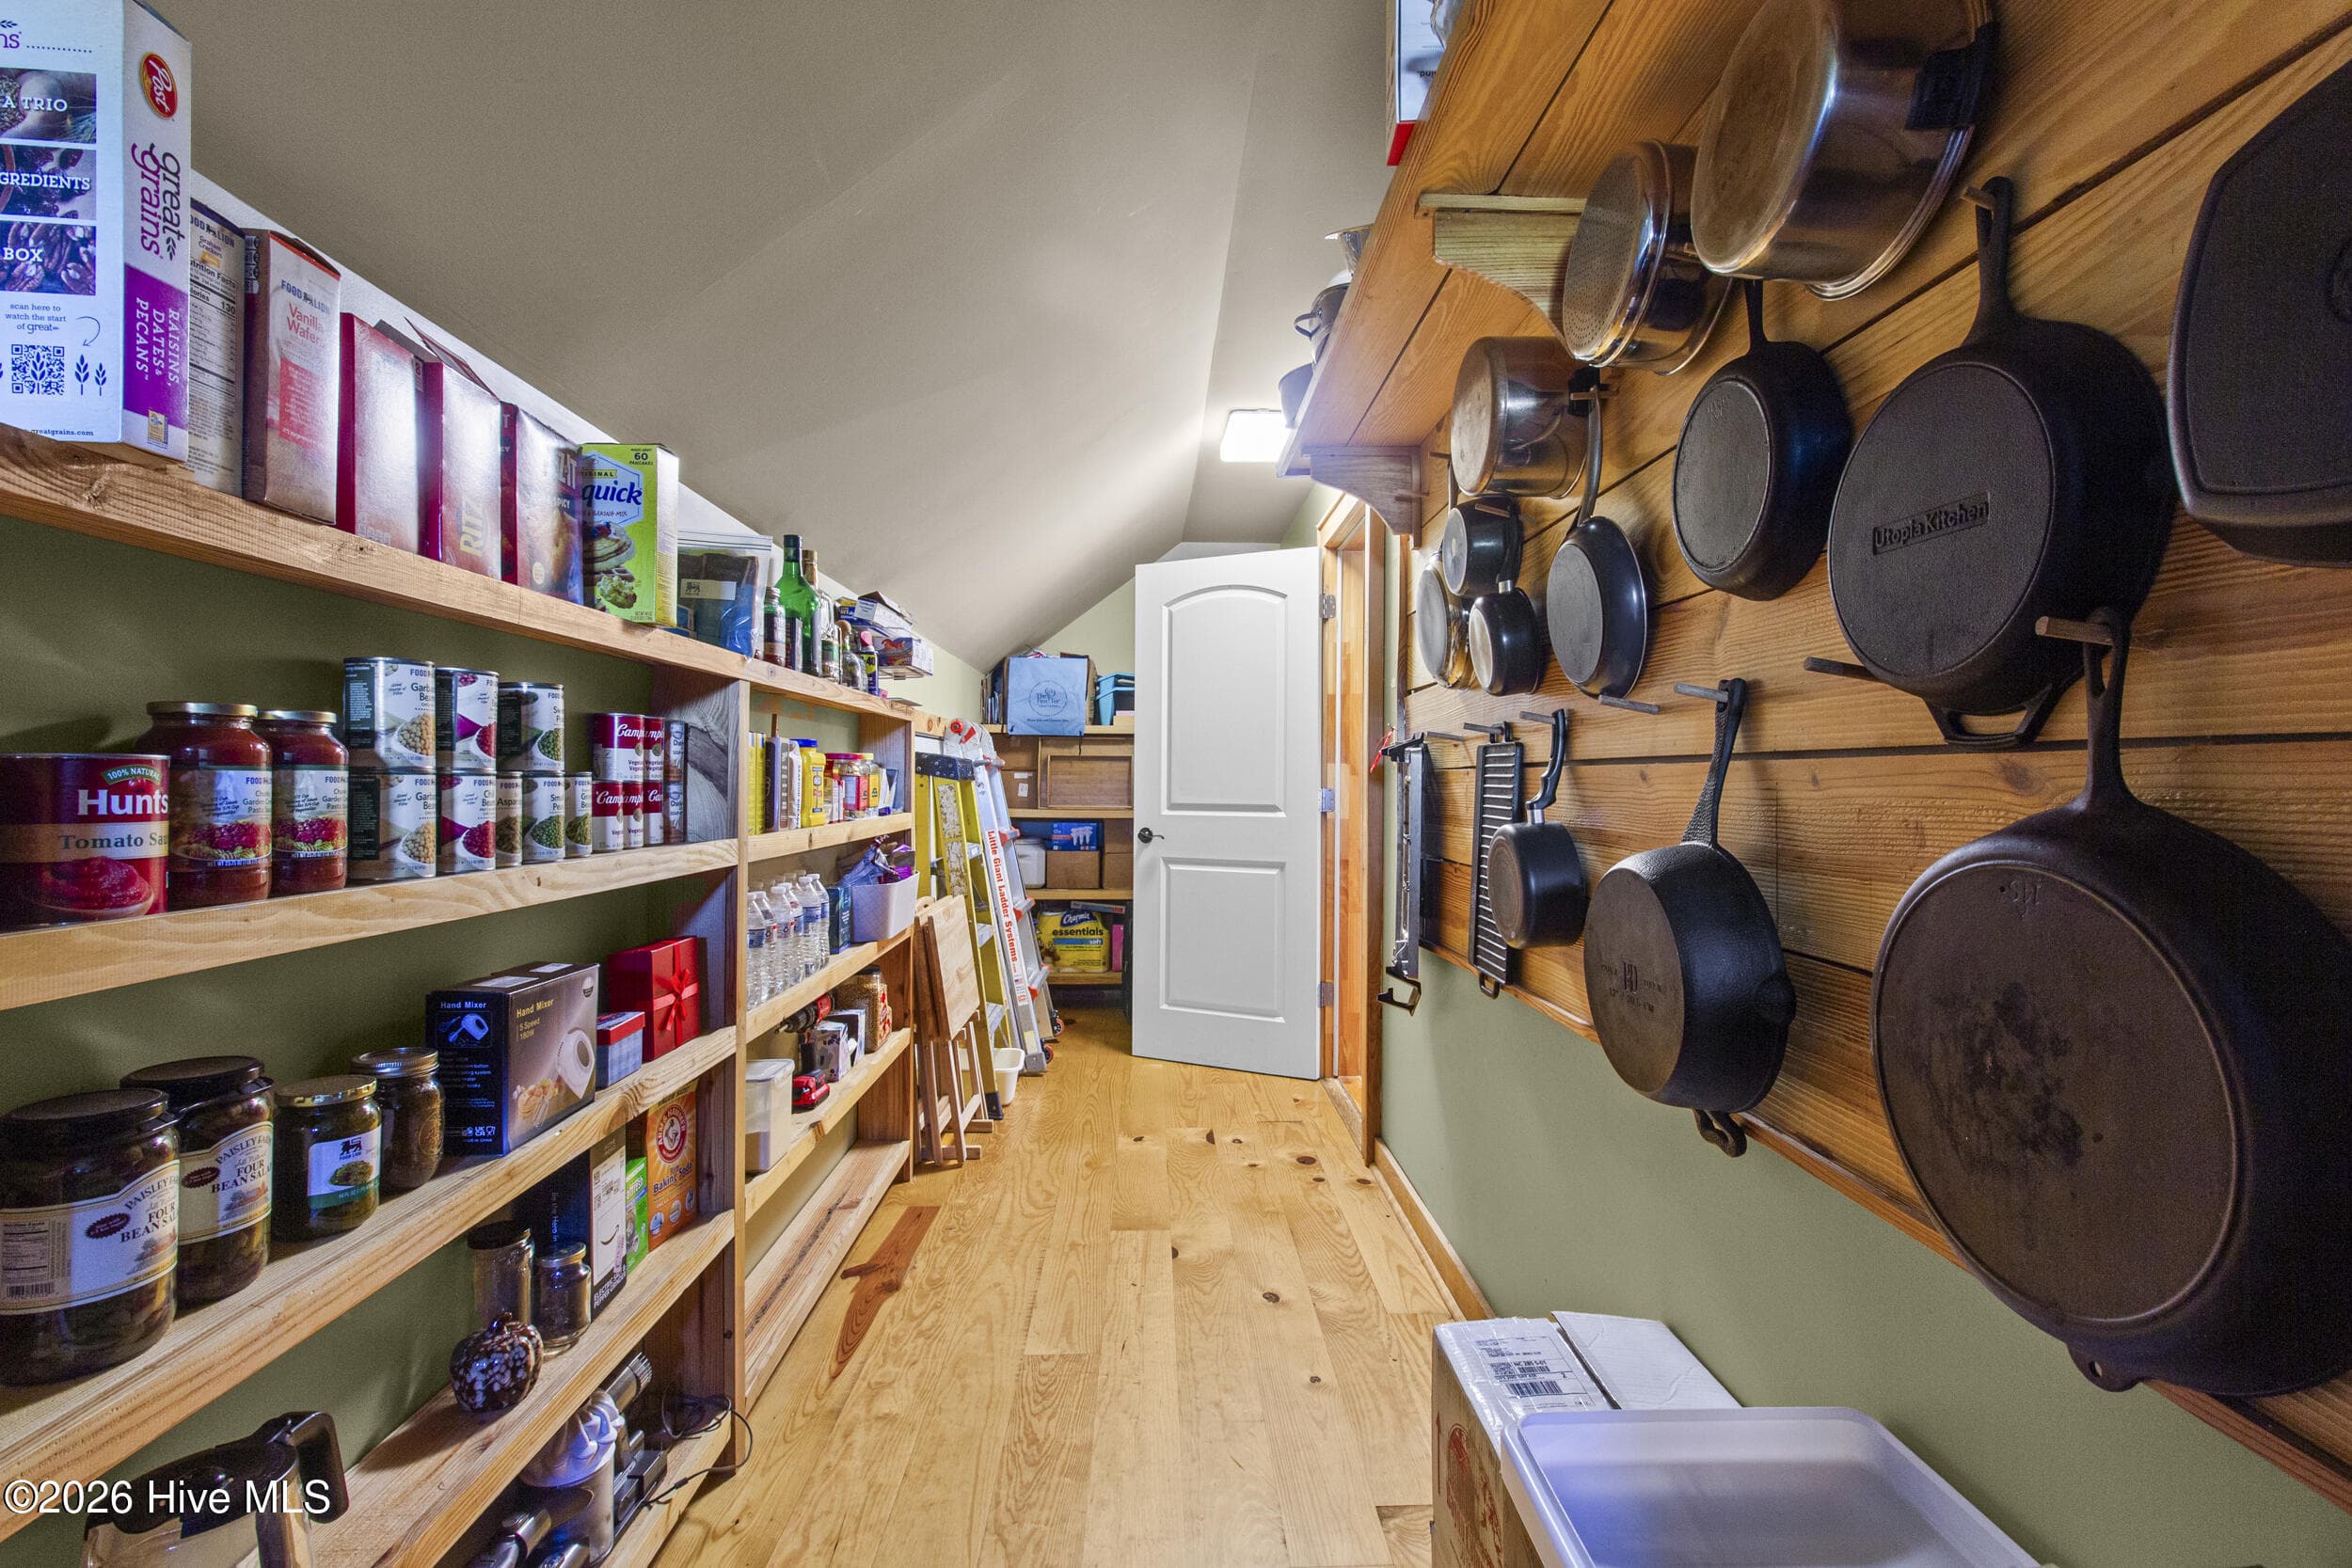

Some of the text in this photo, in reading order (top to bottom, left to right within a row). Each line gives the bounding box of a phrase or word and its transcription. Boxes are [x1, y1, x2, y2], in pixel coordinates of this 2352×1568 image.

[148, 57, 173, 113] Post
[2, 95, 68, 112] A TRIO
[132, 143, 162, 256] grains
[151, 143, 185, 241] great
[3, 247, 43, 262] BOX
[190, 257, 215, 279] utrition
[281, 279, 302, 299] FOOD
[5, 312, 67, 323] watch the start
[9, 303, 29, 311] scan
[31, 303, 51, 312] here
[27, 323, 53, 334] great
[135, 296, 150, 375] PECANS
[152, 309, 166, 371] DATES
[168, 308, 181, 388] RAISINS,
[634, 452, 648, 461] 60
[1875, 501, 1990, 547] Utopia Kitchen
[410, 669, 427, 677] FOOD
[107, 767, 161, 782] 100% NATURAL
[245, 777, 262, 785] FOOD
[58, 832, 145, 850] Tomato
[986, 830, 999, 856] Little
[993, 857, 1005, 883] Giant
[997, 884, 1010, 918] Ladder
[1005, 920, 1019, 963] Systems
[1052, 927, 1104, 936] essentials
[440, 1001, 487, 1010] Hand Mixer
[516, 997, 554, 1019] Hand Mixer
[215, 1134, 261, 1165] PAISLEY
[236, 1158, 265, 1179] FOUR
[678, 1163, 692, 1176] Soda
[124, 1177, 168, 1212] PAISLEY
[210, 1175, 248, 1195] BEAN
[653, 1174, 677, 1194] Baking
[148, 1203, 177, 1224] FOUR
[119, 1220, 160, 1243] BEAN
[551, 1234, 559, 1243] in
